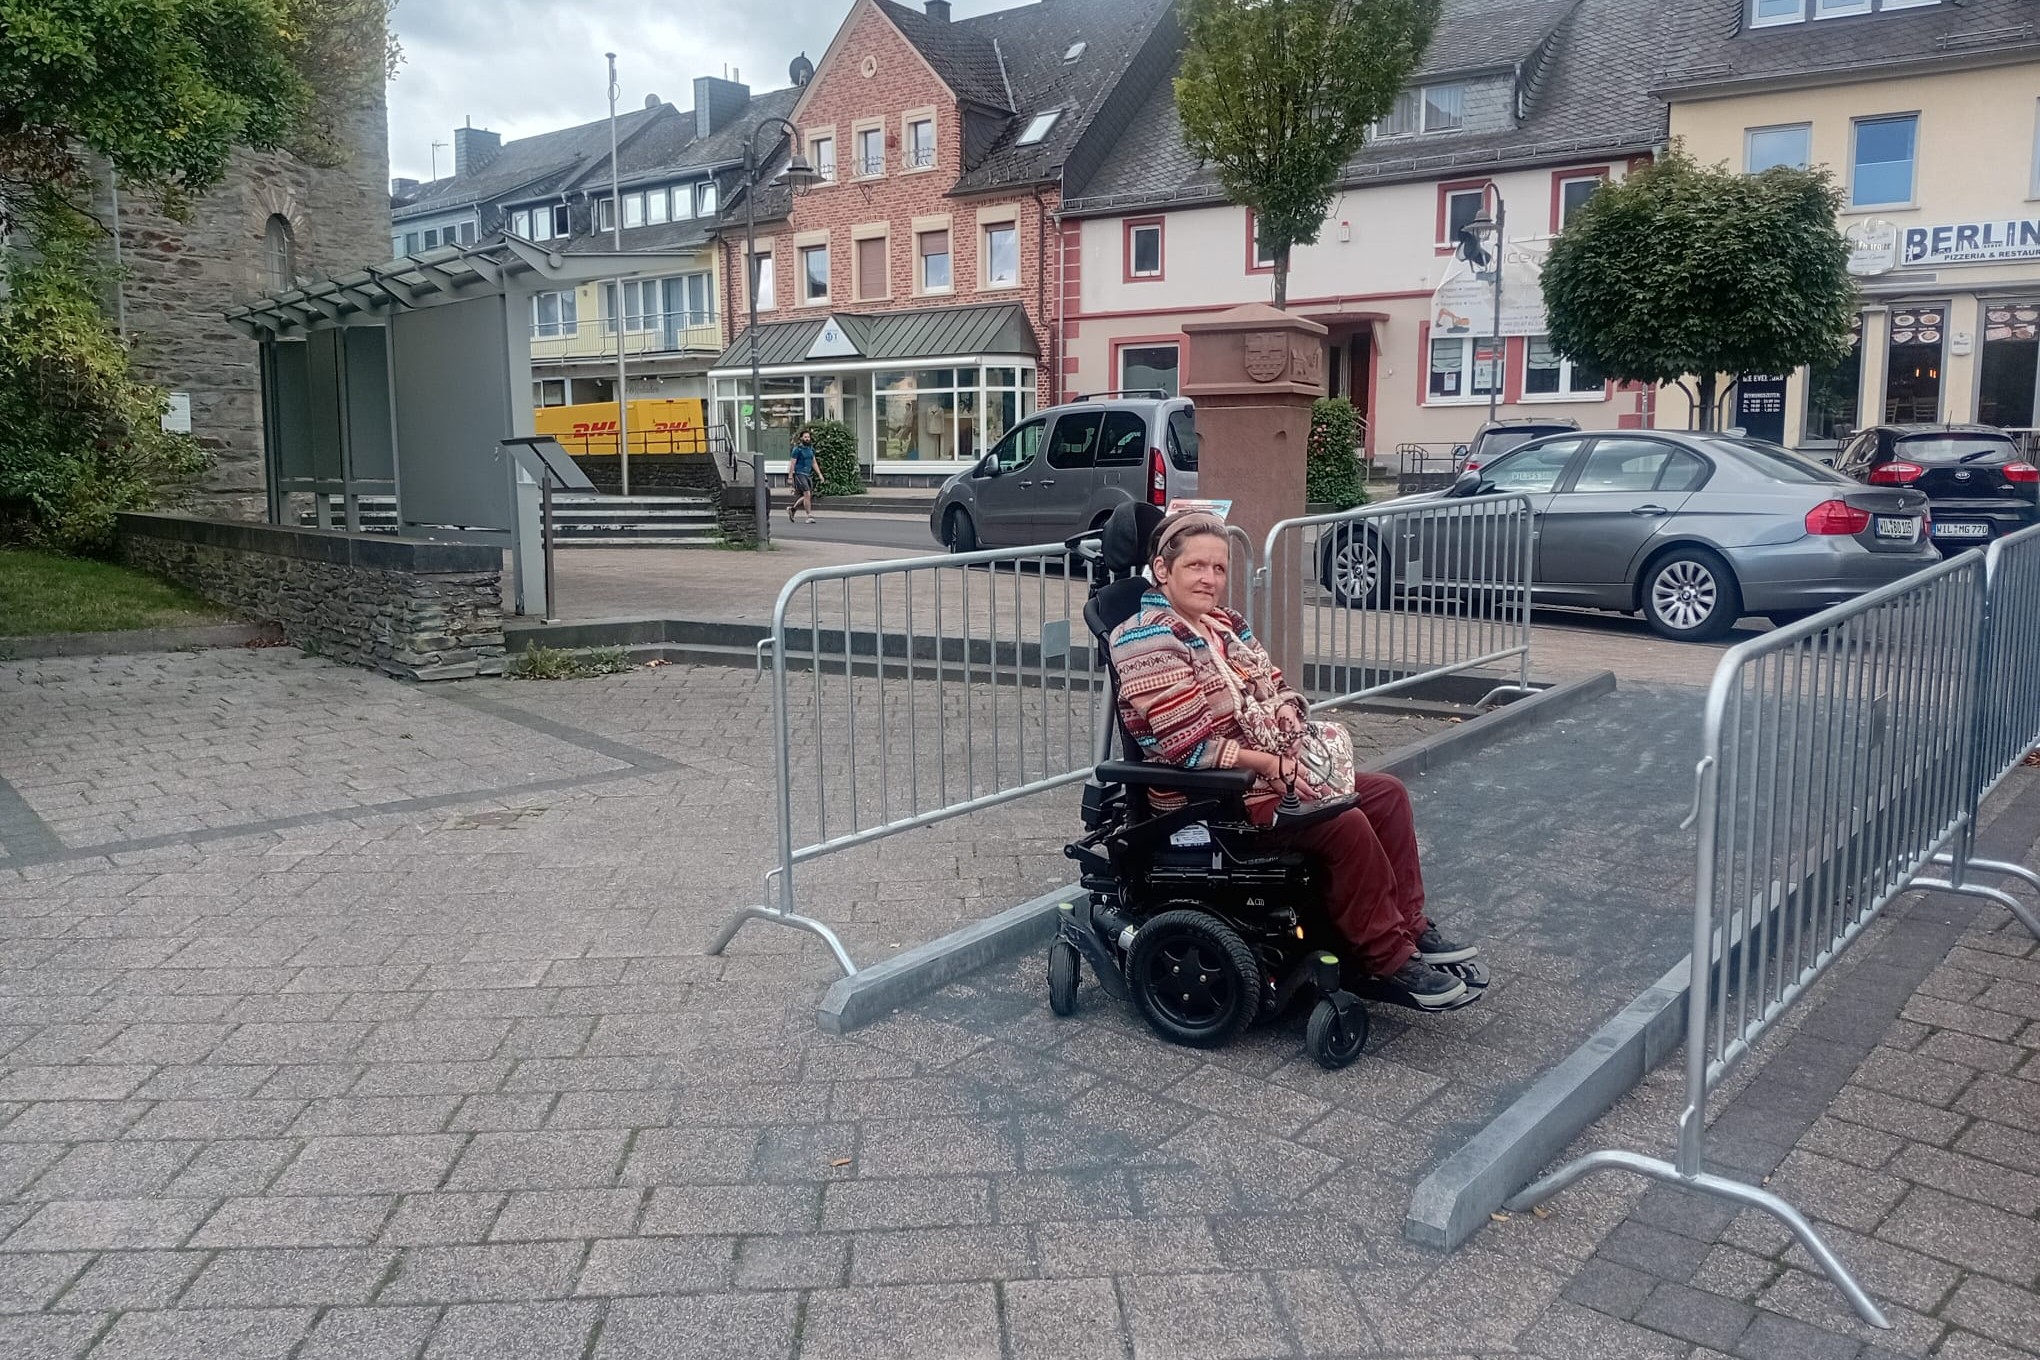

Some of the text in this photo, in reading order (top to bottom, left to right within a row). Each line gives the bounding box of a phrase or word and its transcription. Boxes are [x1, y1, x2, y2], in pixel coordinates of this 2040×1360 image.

[1944, 251, 1986, 261] PIZZERIA
[572, 421, 618, 438] DHL
[654, 421, 691, 433] DHL
[1937, 524, 1988, 534] WIL MG 770
